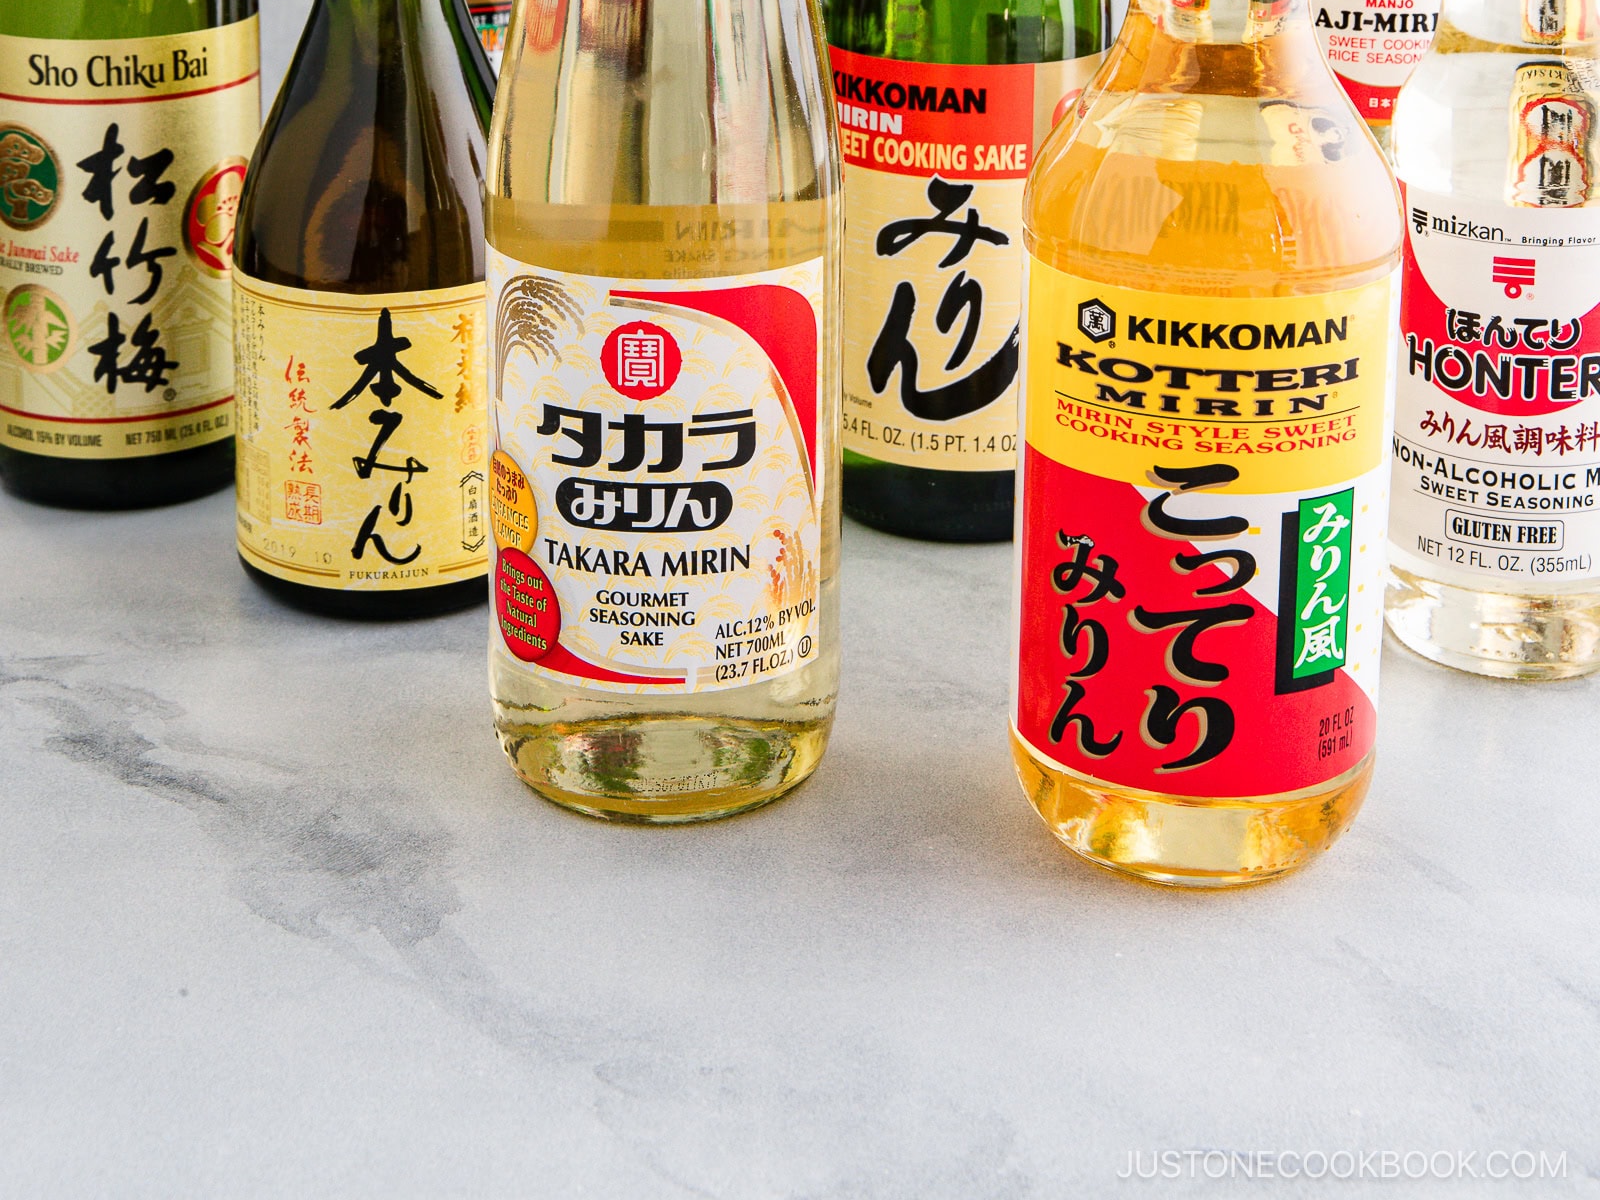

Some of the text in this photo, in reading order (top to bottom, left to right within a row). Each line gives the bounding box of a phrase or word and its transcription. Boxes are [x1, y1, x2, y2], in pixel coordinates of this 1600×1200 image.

[1315, 7, 1439, 33] AJI-MIRI
[1328, 50, 1422, 64] RICE SEASON
[1329, 35, 1431, 51] SWEET COOKIN
[28, 47, 208, 88] Sho Chiku Bai
[843, 129, 1027, 171] EET COOKING SAKE
[1432, 215, 1504, 242] mizkan
[1522, 236, 1563, 246] Bringing
[50, 246, 79, 263] Sake
[76, 122, 179, 395] 松竹梅
[867, 174, 1020, 422] みりん
[1128, 315, 1348, 350] KIKKOMAN
[1446, 309, 1579, 350] ほんてり
[1056, 342, 1360, 392] KOTTERI
[1097, 384, 1328, 416] MIRIN
[7, 424, 102, 447] ALCOHOL 15% BY VOLUME
[126, 433, 142, 446] NET
[146, 430, 162, 445] 750
[165, 428, 178, 441] ML
[203, 418, 214, 434] FL.
[329, 308, 444, 564] 本みりん
[843, 412, 858, 434] 5.4
[861, 420, 878, 440] FL.
[883, 426, 905, 446] OZ.
[911, 431, 939, 452] (1.5
[945, 435, 967, 452] PT.
[974, 436, 995, 452] 1.4
[1056, 414, 1357, 454] COOKING SEASONING
[1057, 399, 1357, 440] MIRIN STYLE SWEET
[1420, 410, 1600, 456] みりん風調味料
[537, 403, 756, 473] タカラ
[569, 486, 717, 531] みりん
[1420, 476, 1595, 510] SWEET SEASONING
[1452, 516, 1557, 544] GLUTEN FREE
[545, 538, 751, 577] TAKARA MIRIN
[1418, 535, 1592, 577] NET 12 FL. OZ. (355mL)
[349, 567, 430, 580] FUKURAIJUN
[502, 558, 544, 591] Brings out
[1295, 502, 1349, 669] みりん風
[500, 578, 547, 613] the Taste of
[596, 589, 689, 607] GOURMET
[778, 608, 793, 626] BY
[794, 598, 817, 618] VOL.
[506, 600, 537, 628] Natural
[589, 607, 696, 627] SEASONING
[1130, 463, 1256, 773] こってり
[501, 613, 547, 651] Ingredients
[620, 630, 664, 647] SAKE
[715, 630, 786, 661] NET 700ML
[1051, 529, 1126, 758] みりん
[715, 659, 748, 683] (23.7
[1319, 717, 1330, 737] 20
[1332, 712, 1342, 733] FL
[1318, 735, 1336, 762] (591
